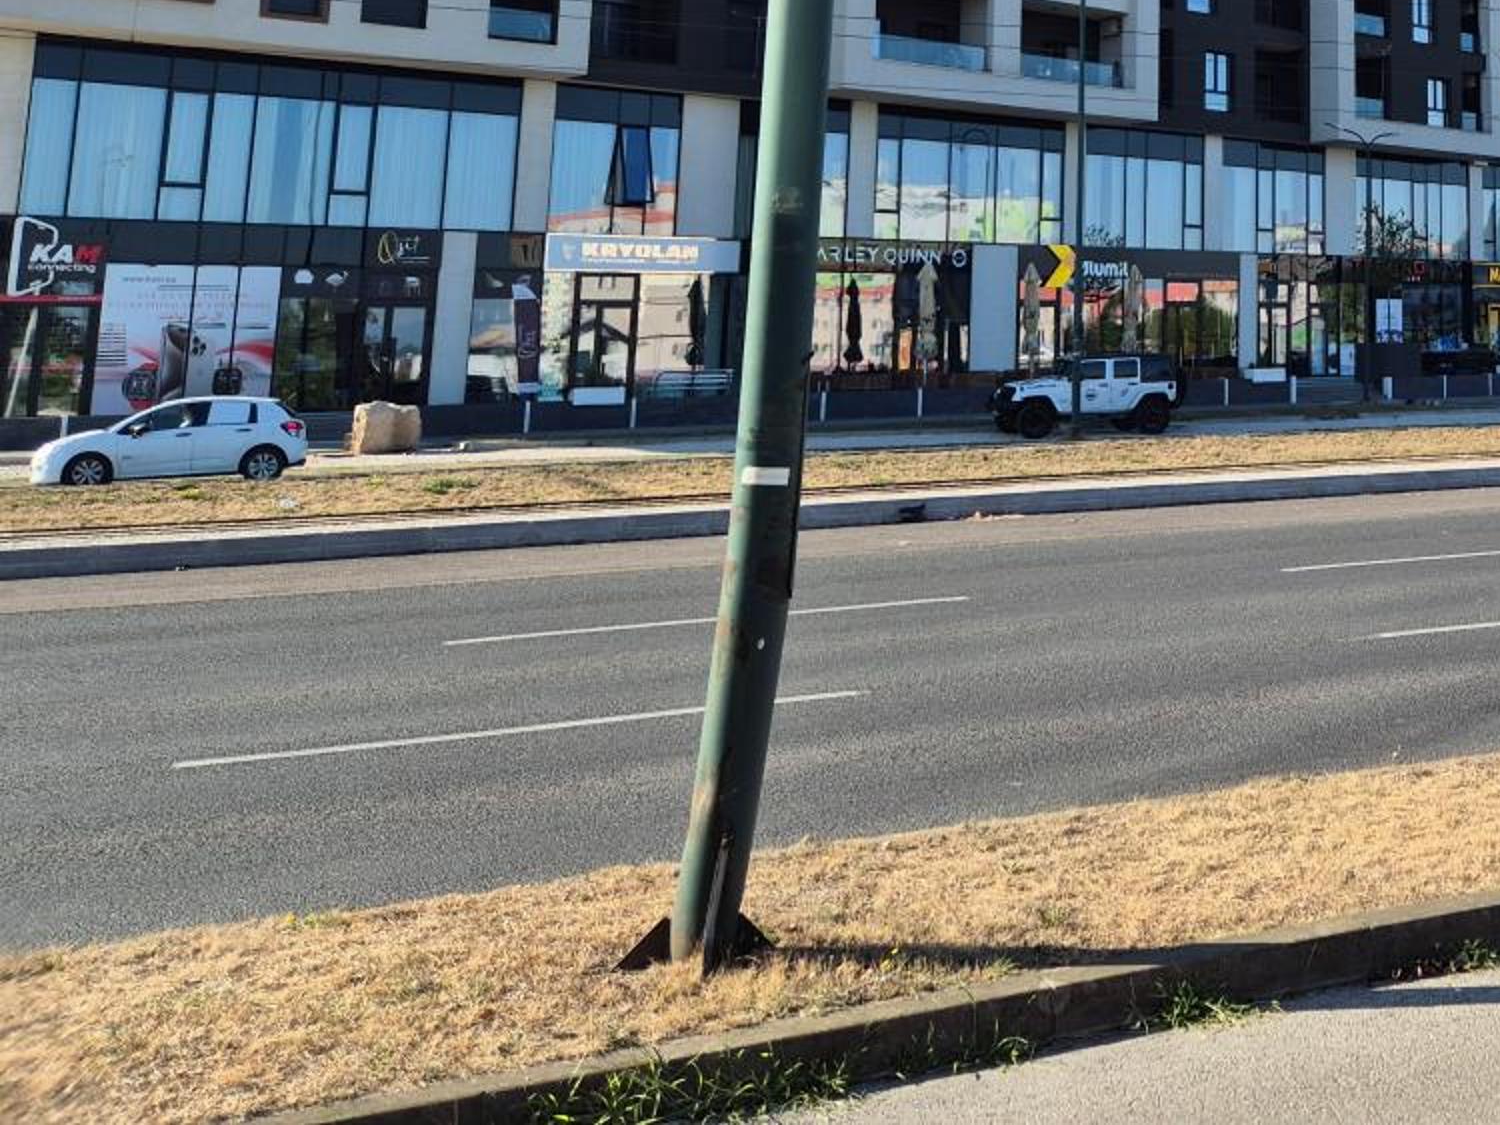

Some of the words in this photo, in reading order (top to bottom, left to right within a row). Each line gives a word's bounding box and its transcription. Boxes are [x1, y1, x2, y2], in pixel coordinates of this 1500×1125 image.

[581, 242, 700, 259] KRYOLAN
[817, 246, 879, 263] ARLEY
[883, 247, 942, 265] QUINN
